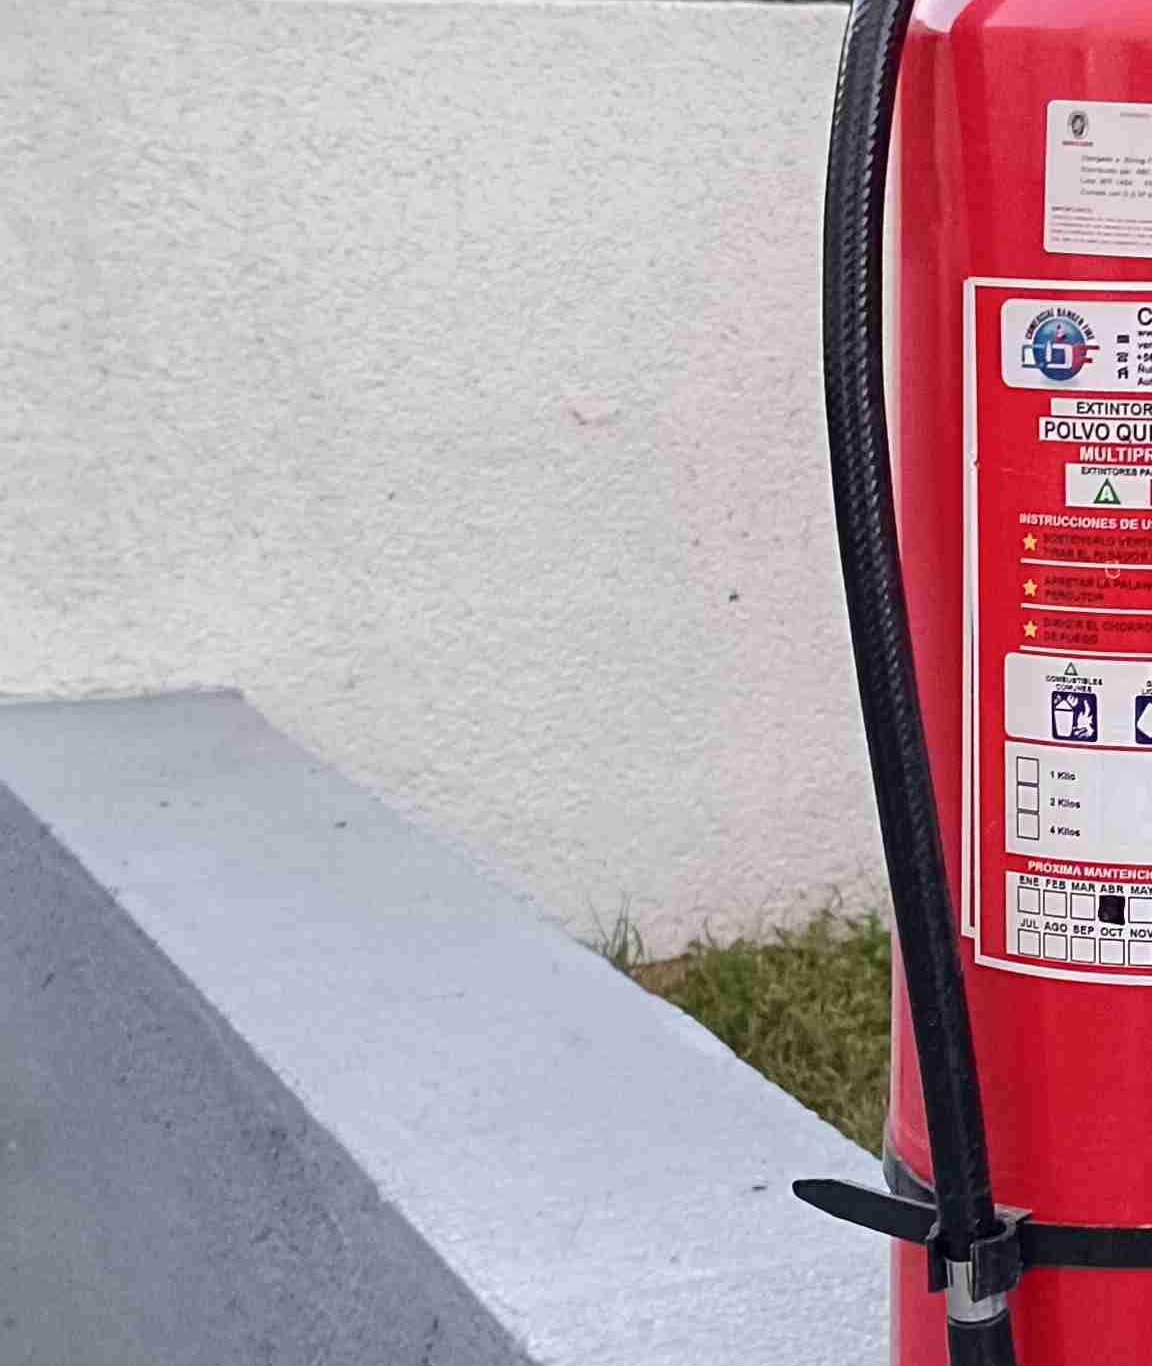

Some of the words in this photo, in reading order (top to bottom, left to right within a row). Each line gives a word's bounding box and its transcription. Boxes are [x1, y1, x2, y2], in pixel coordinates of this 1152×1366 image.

[1076, 401, 1152, 416] EXTINTOR
[1044, 421, 1110, 441] POLVO
[1080, 466, 1138, 477] EXTINTORES
[1019, 513, 1117, 530] INSTRUCCIONES
[1120, 518, 1138, 530] DE
[1057, 771, 1076, 781] Kilo
[1057, 798, 1081, 809] Kilos
[1057, 826, 1081, 837] Kilos
[1019, 875, 1040, 885] ENE
[1045, 878, 1066, 890] FEB
[1071, 881, 1096, 893] MAR
[1100, 884, 1124, 894] ABR
[1020, 918, 1040, 930] JUL
[1044, 921, 1068, 933] AGO
[1073, 924, 1095, 935] SEP
[1100, 926, 1123, 937] OCT
